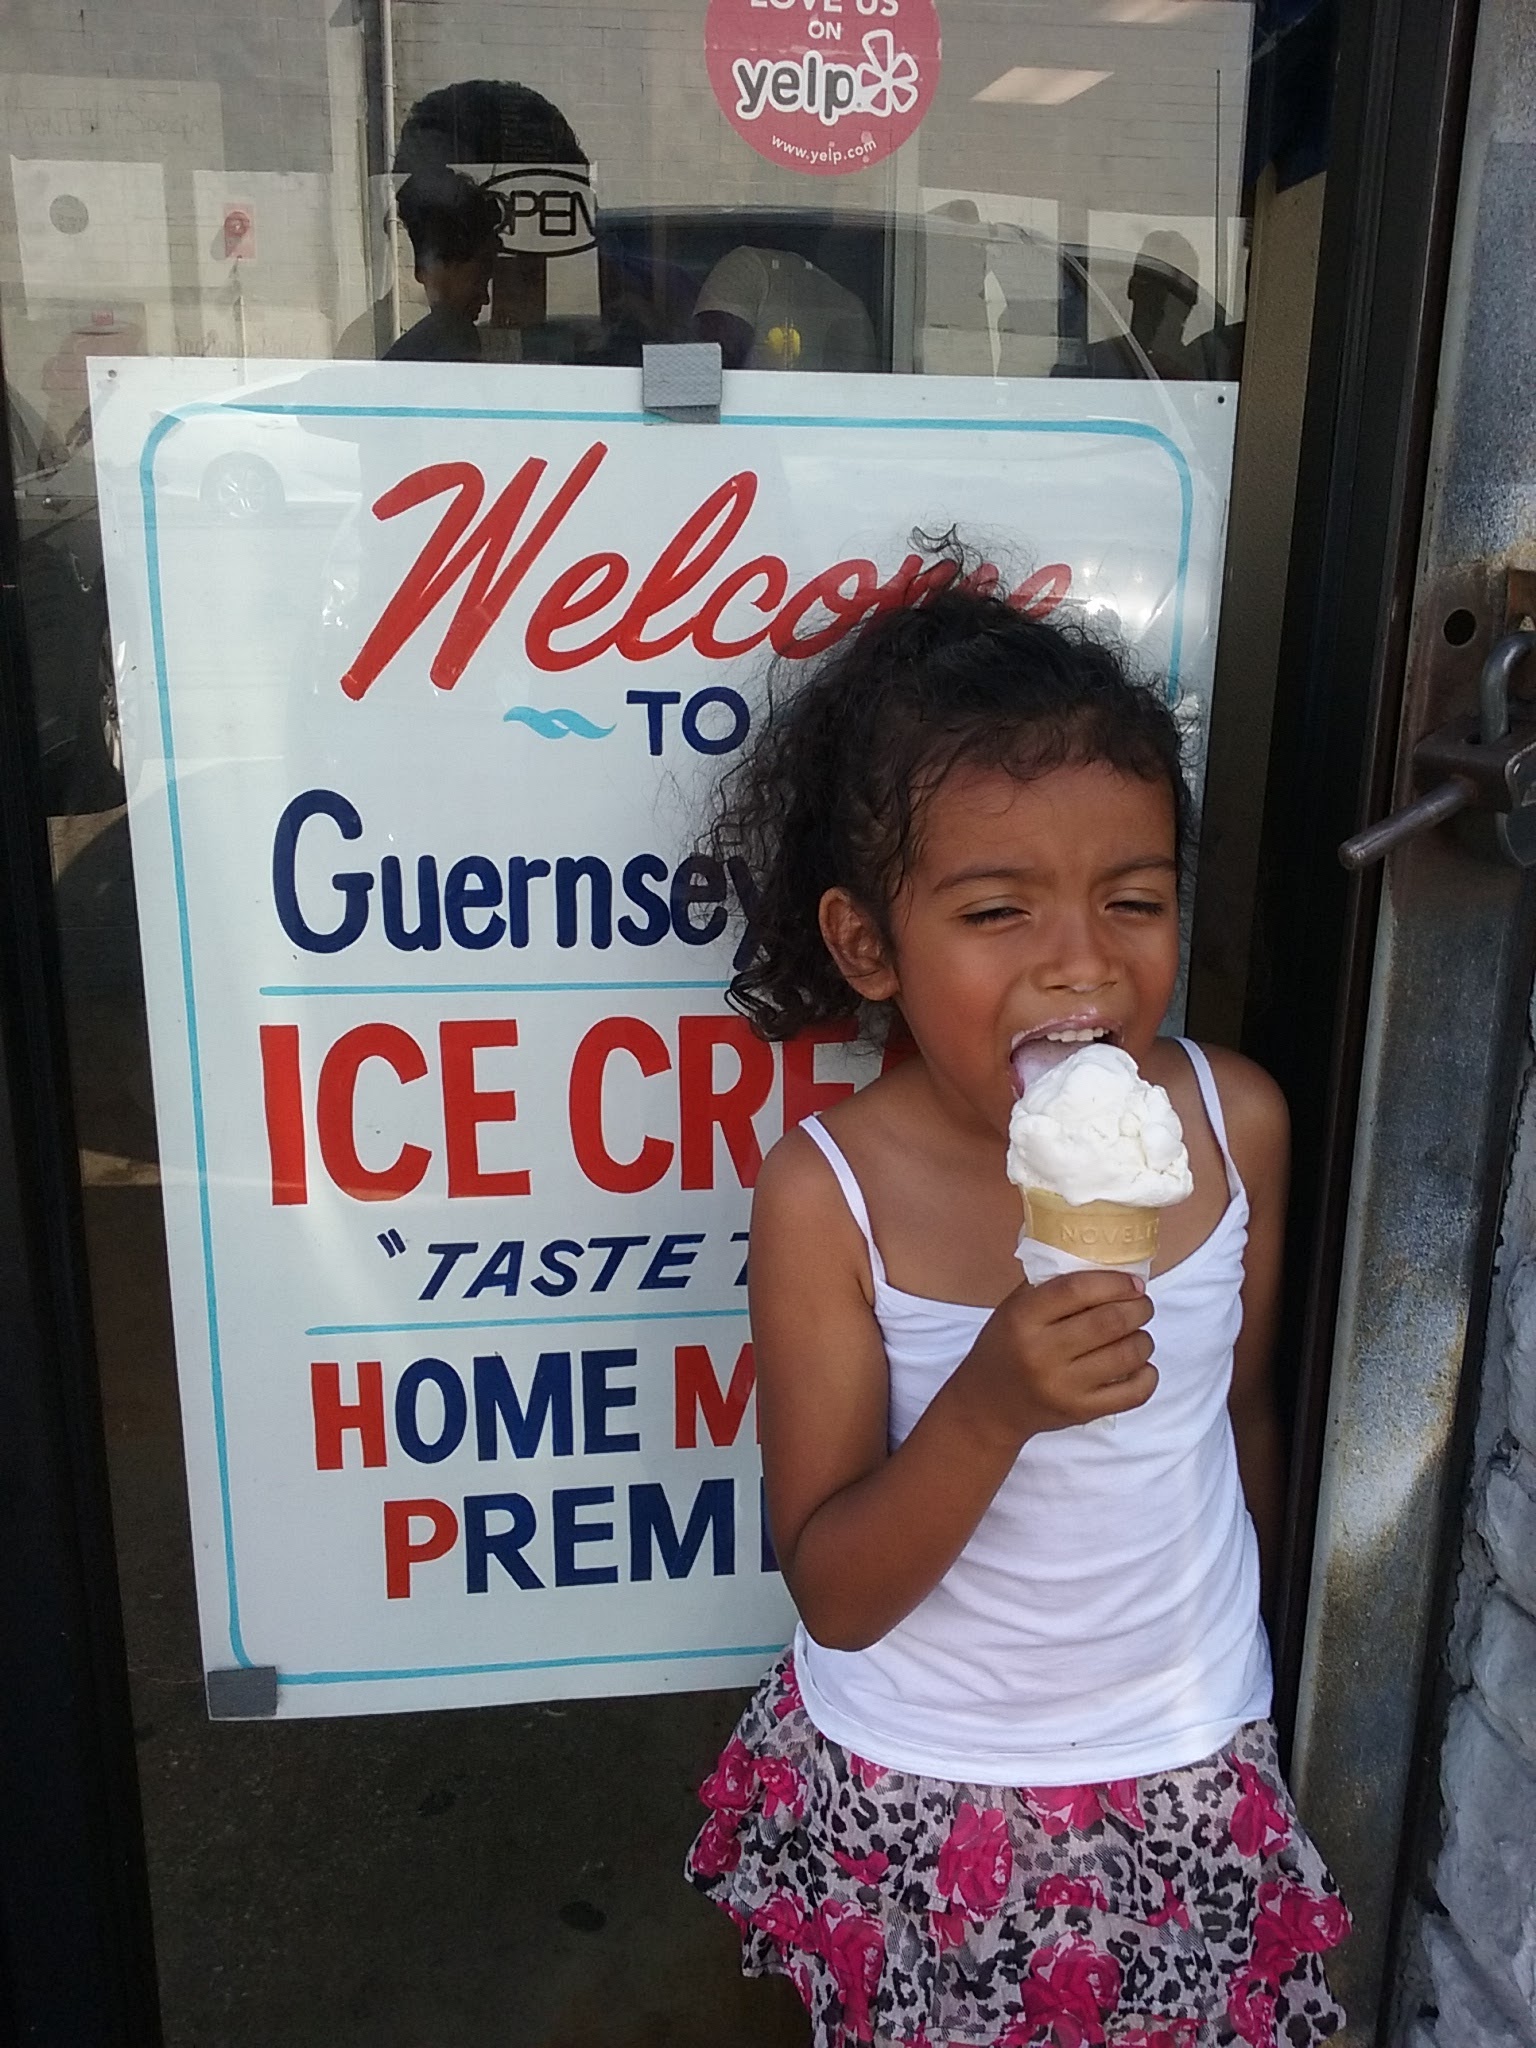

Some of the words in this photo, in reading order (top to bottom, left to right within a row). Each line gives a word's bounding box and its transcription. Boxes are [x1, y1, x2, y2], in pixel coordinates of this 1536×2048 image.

[808, 20, 842, 40] ON
[734, 51, 856, 124] yelp
[771, 135, 877, 165] www.yelp.com
[627, 687, 749, 756] TO
[260, 1018, 531, 1206] ICE
[568, 1013, 900, 1194] CRE
[310, 1348, 641, 1471] HOME
